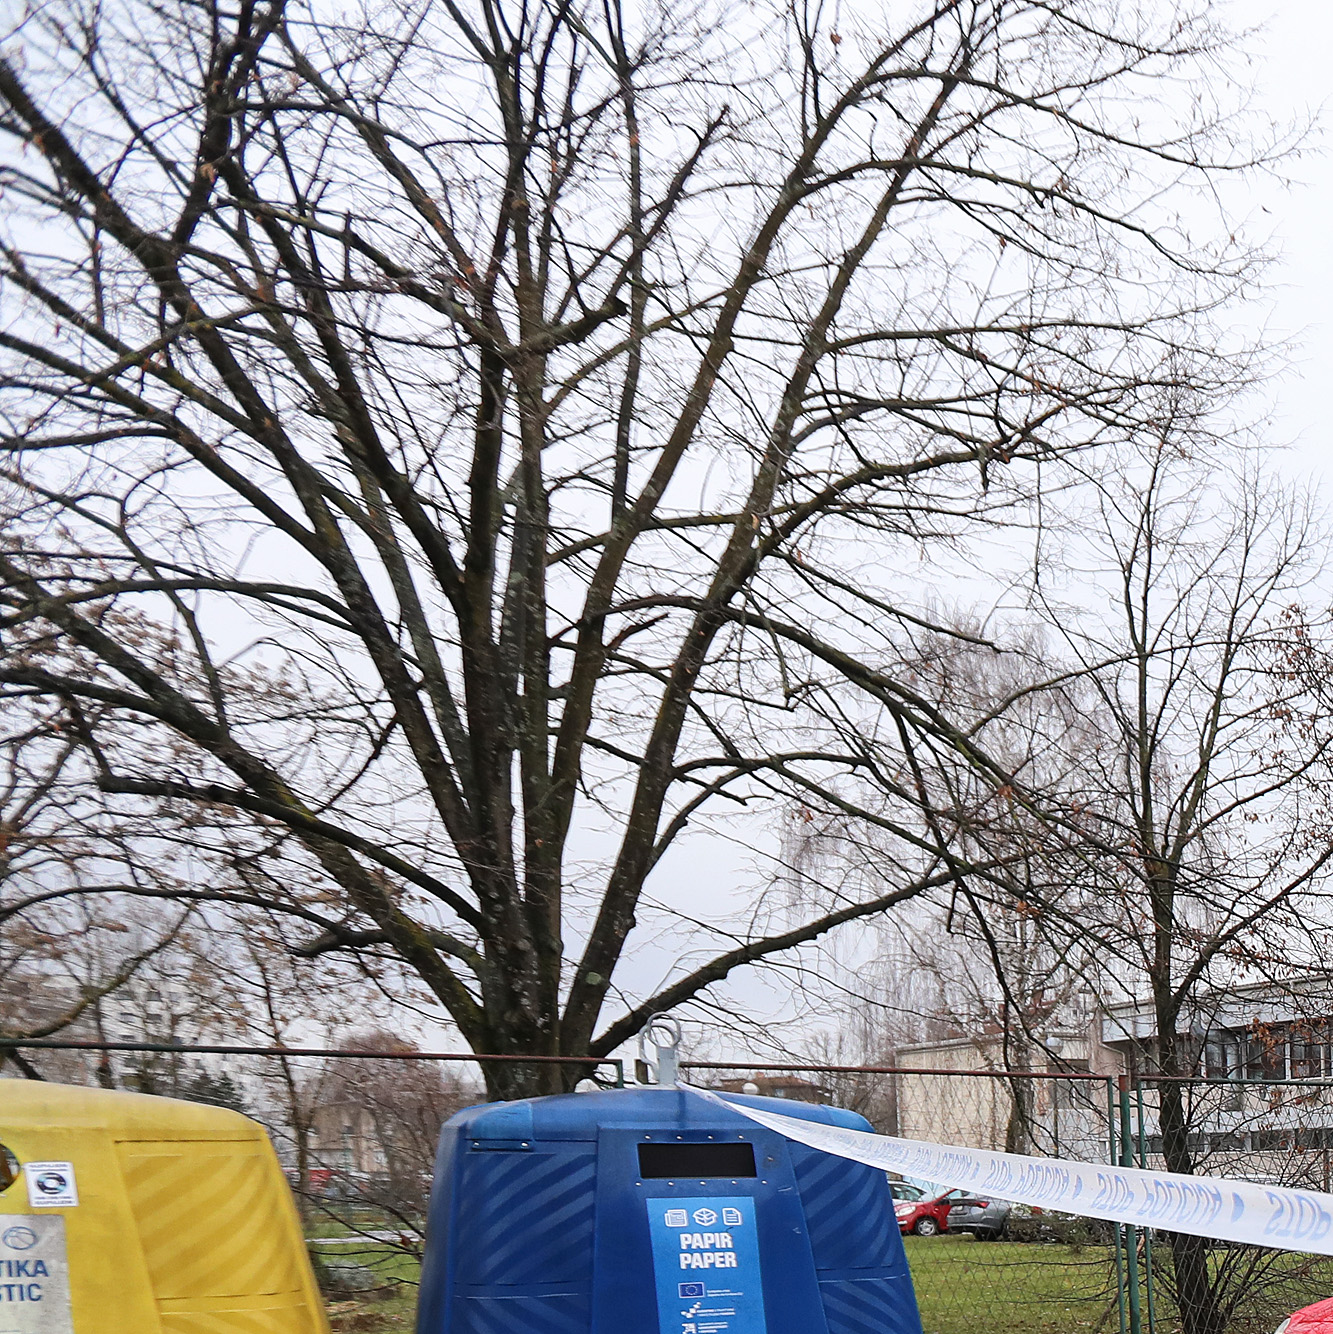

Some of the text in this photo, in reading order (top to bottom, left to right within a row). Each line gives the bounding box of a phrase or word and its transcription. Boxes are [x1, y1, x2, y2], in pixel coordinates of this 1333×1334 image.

[679, 1232, 734, 1250] PAPIR
[679, 1251, 738, 1269] PAPER
[0, 1284, 42, 1301] TIC
